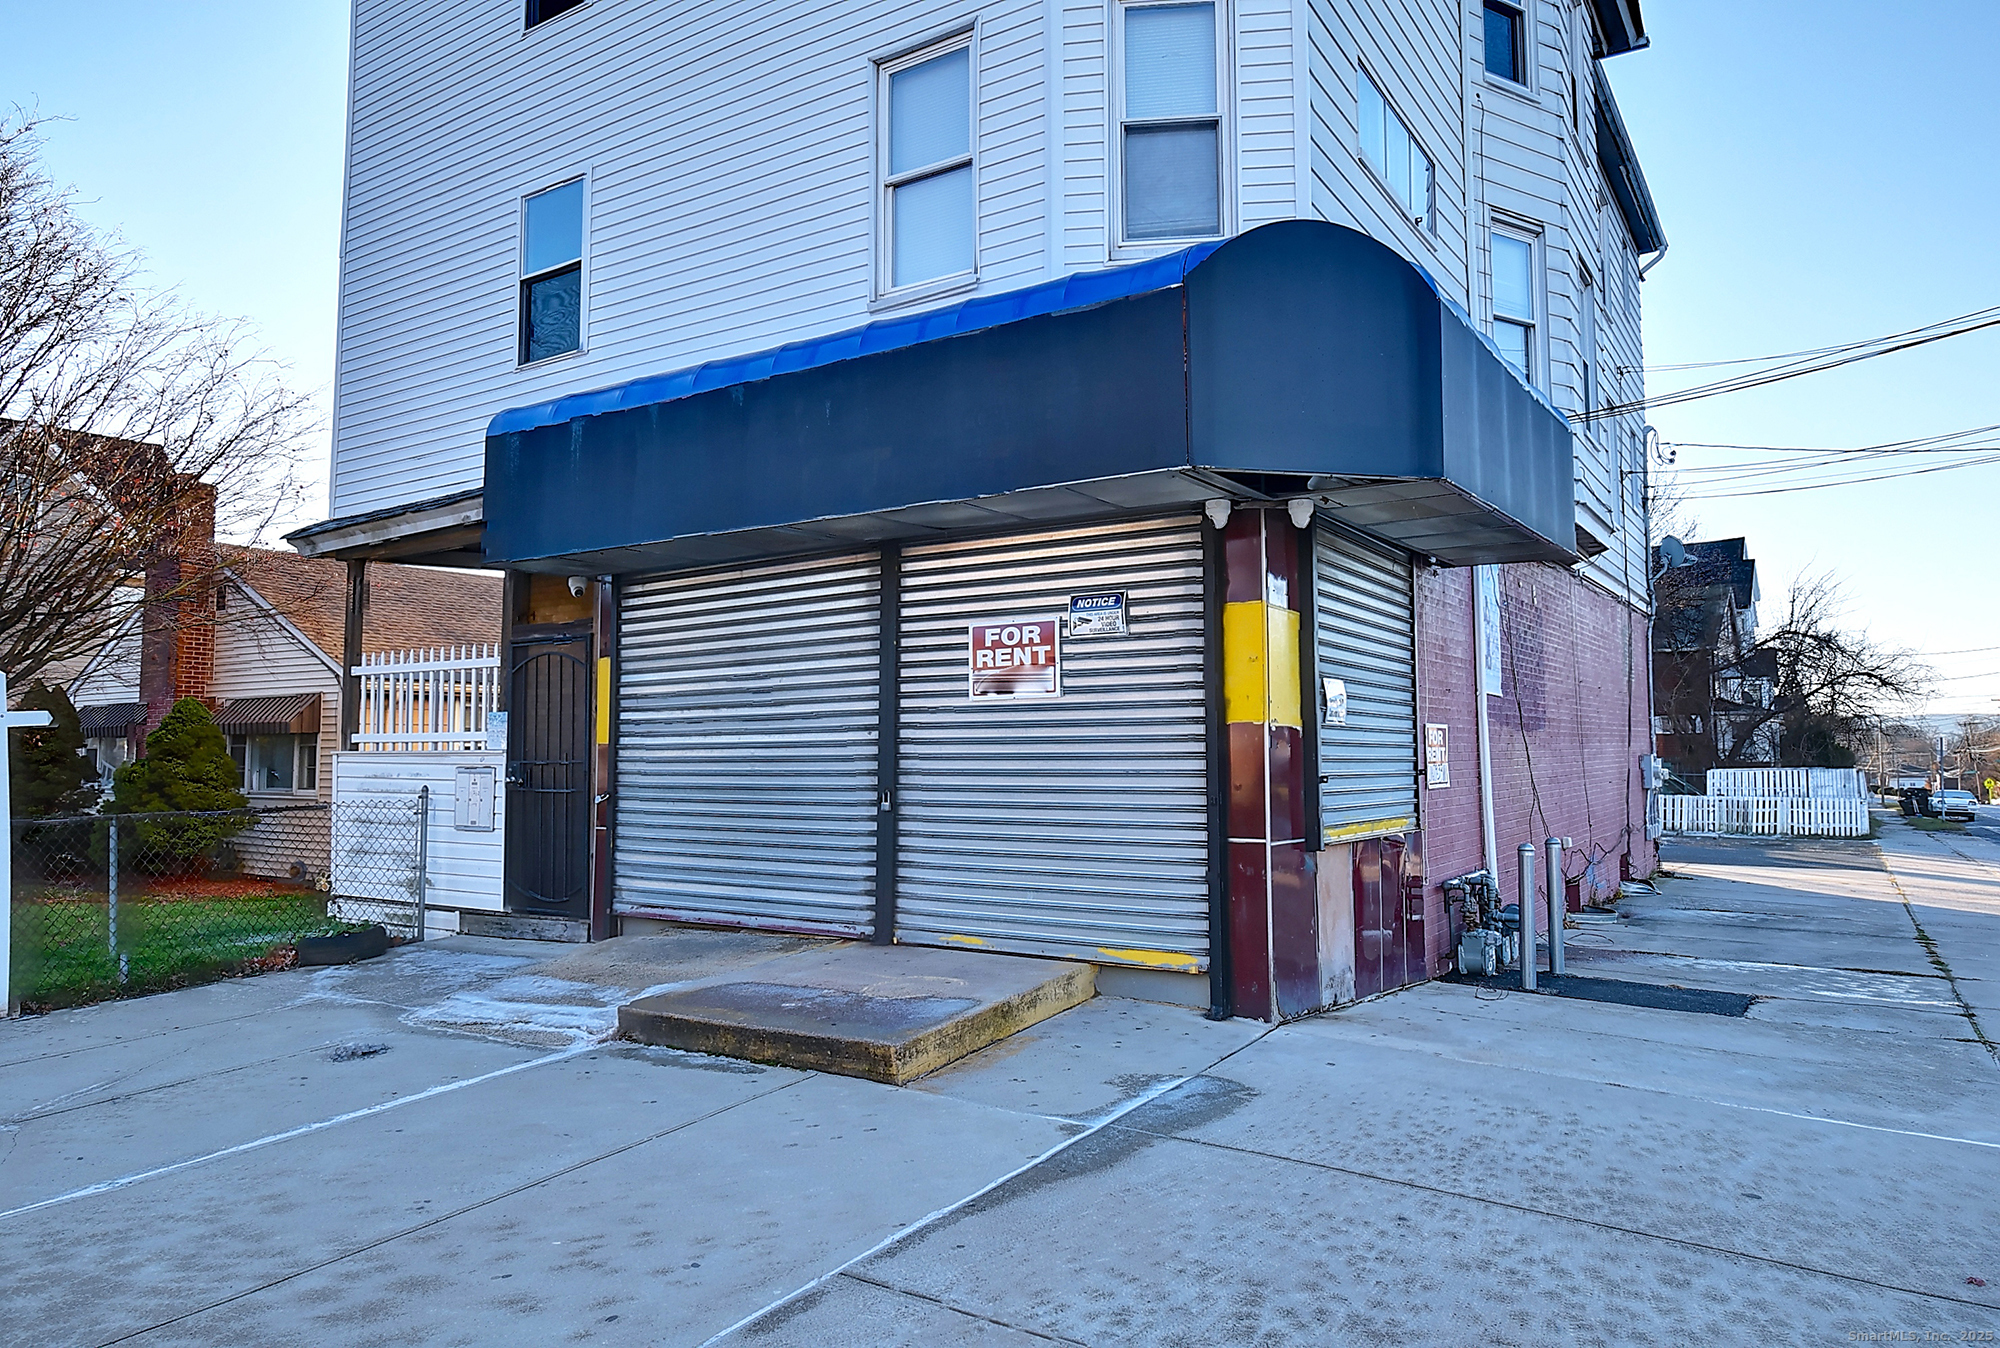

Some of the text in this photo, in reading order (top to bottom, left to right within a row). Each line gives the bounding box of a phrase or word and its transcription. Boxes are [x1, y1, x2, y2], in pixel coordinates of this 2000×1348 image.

[1076, 597, 1116, 608] NOTICE
[985, 625, 1041, 647] FOR
[976, 645, 1051, 668] RENT
[1429, 729, 1443, 745] FOR
[1428, 747, 1445, 762] RENT
